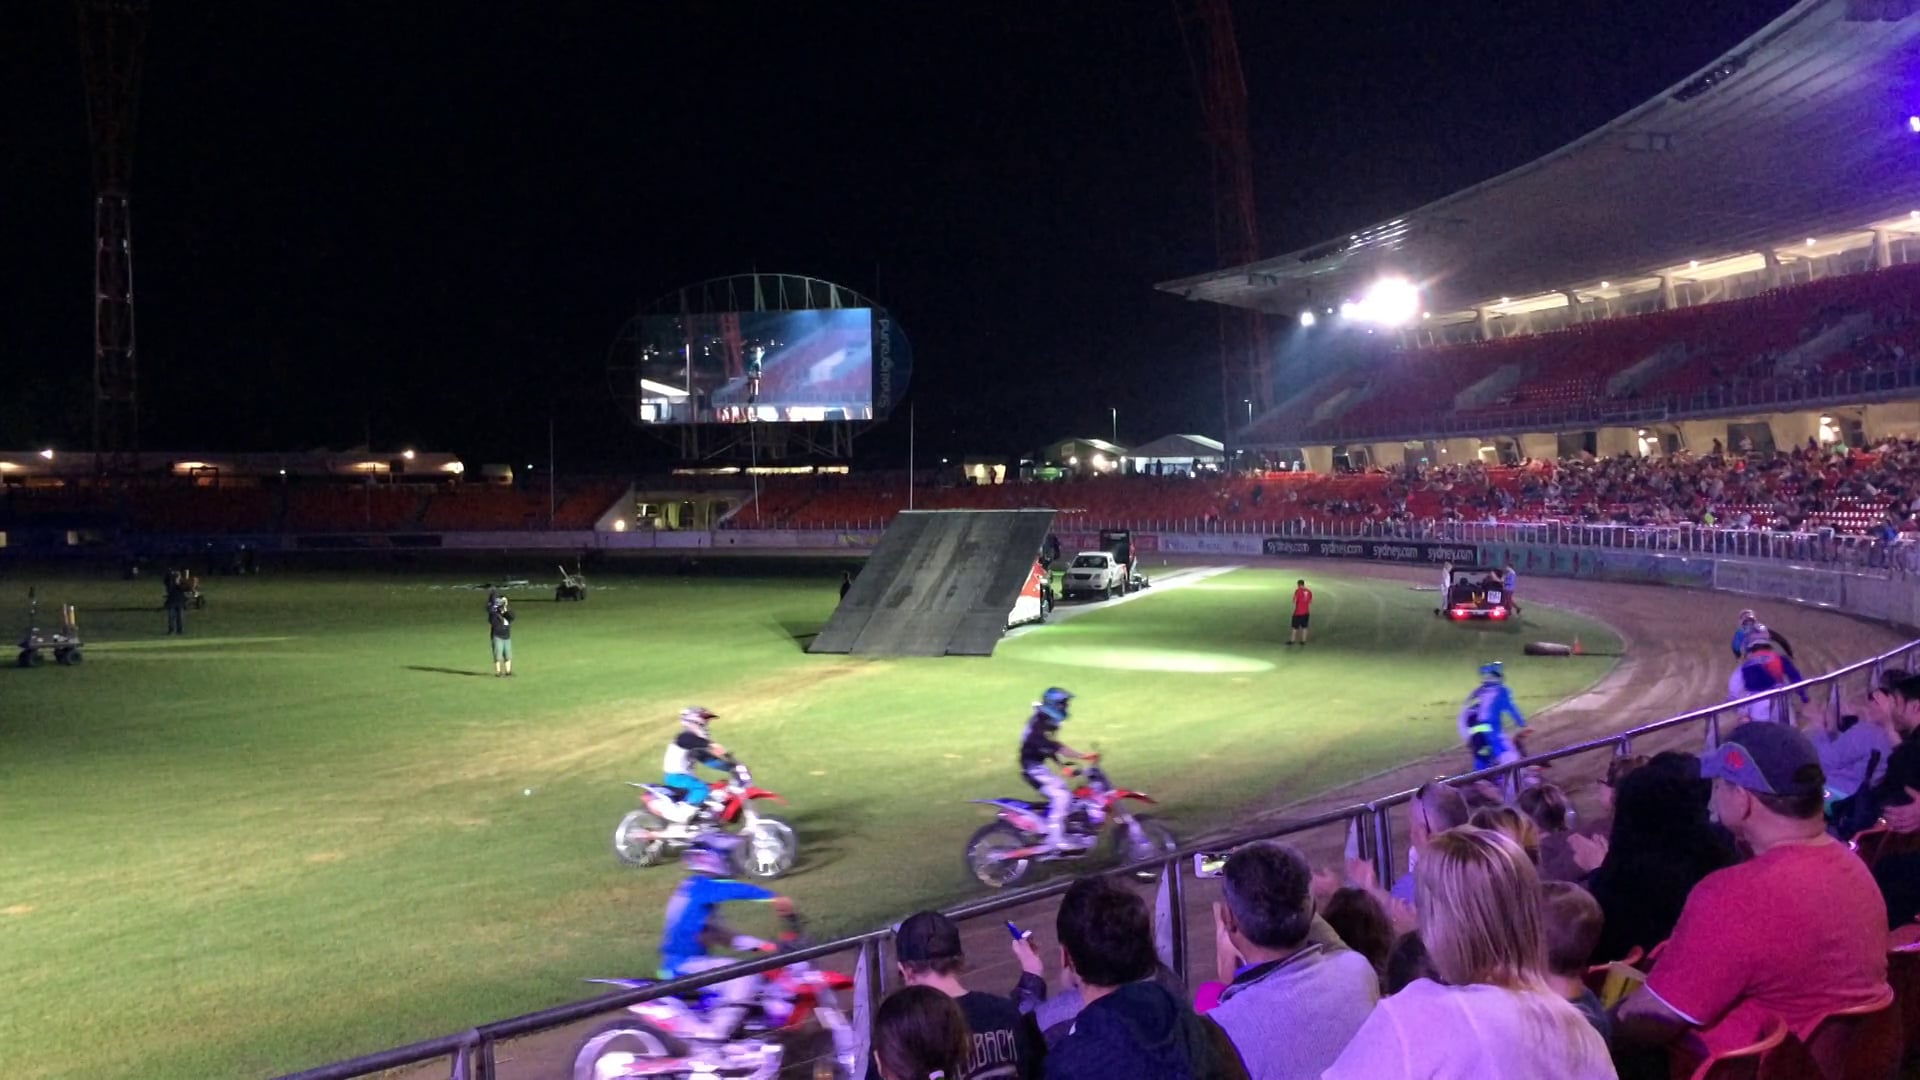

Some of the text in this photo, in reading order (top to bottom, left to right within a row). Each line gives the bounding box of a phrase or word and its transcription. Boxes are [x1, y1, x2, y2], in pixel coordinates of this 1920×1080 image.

[1320, 542, 1363, 557] sydney.com
[1372, 544, 1418, 560] sydney.com
[1427, 545, 1474, 561] sydney.com
